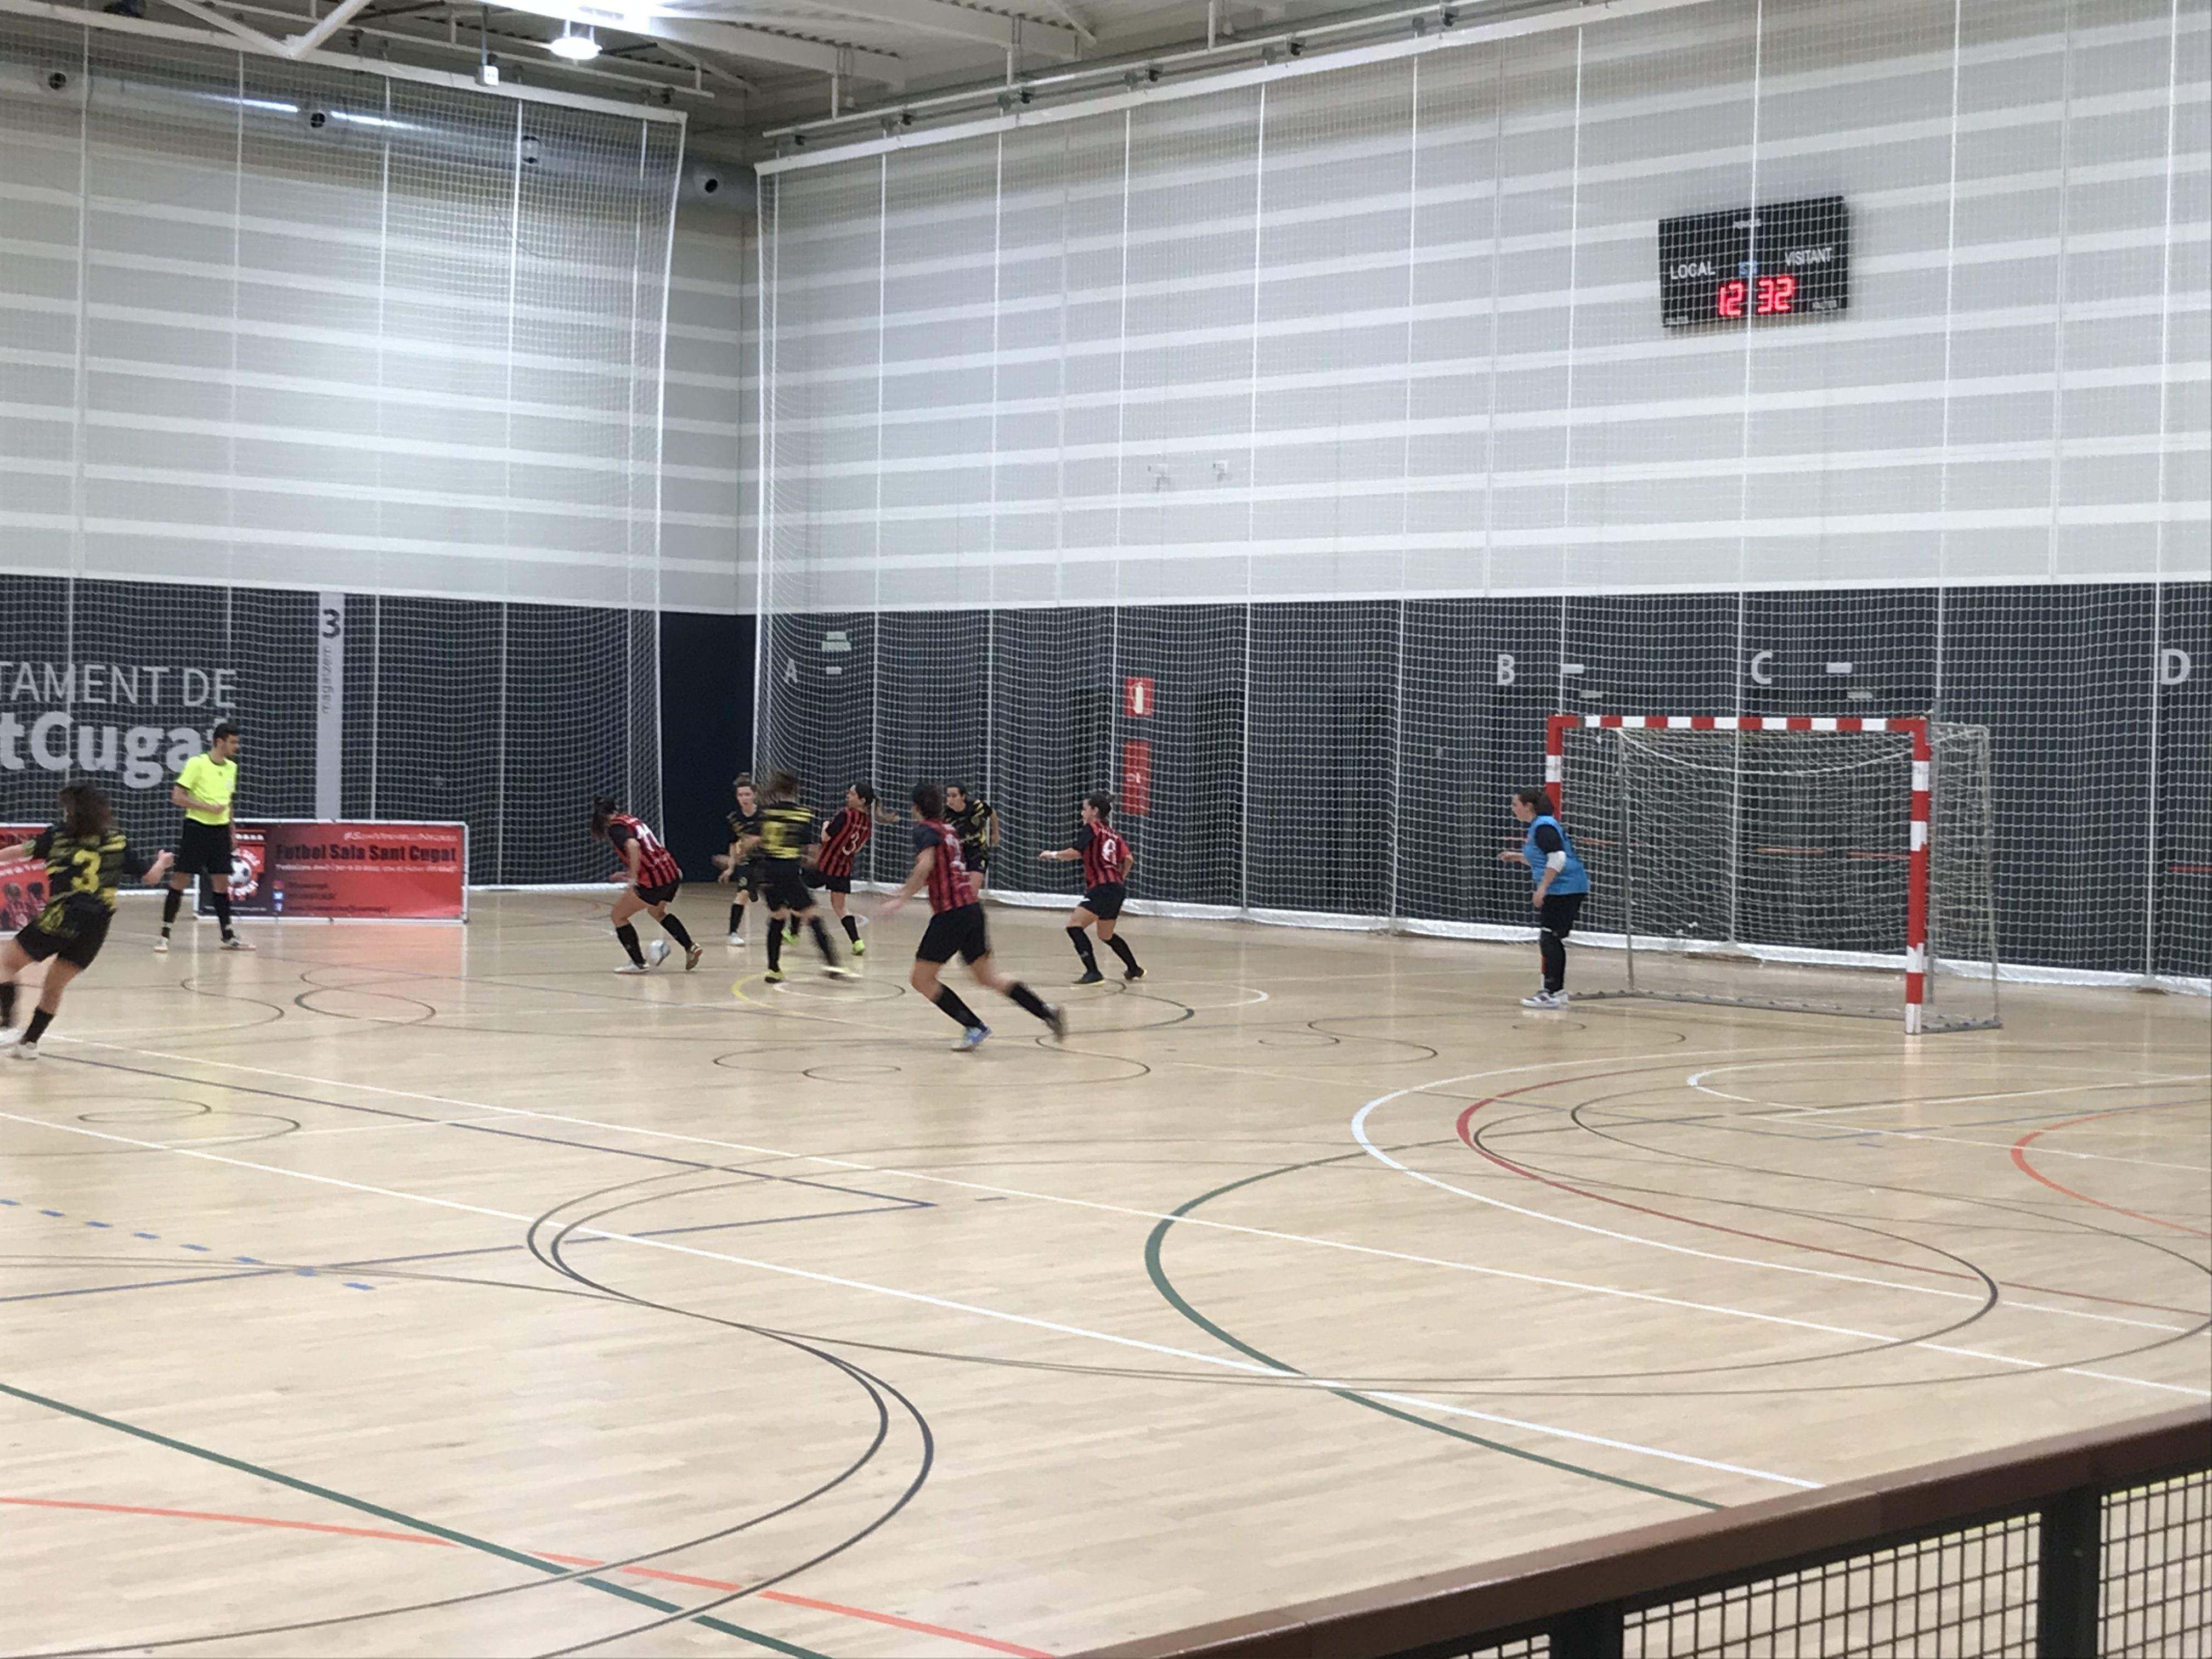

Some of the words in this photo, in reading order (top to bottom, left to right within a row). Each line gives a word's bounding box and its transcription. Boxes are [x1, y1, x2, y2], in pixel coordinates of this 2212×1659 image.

[1671, 261, 1716, 280] LOCAL
[1785, 247, 1832, 267] VISITANT
[1718, 281, 1744, 317] 12
[1757, 275, 1795, 313] 32
[322, 608, 341, 639] 3
[785, 658, 798, 684] A
[1497, 654, 1515, 686] B
[1751, 650, 1774, 685] C
[2160, 648, 2191, 685] D
[183, 667, 236, 708] DE
[275, 844, 326, 860] Futbol
[329, 843, 366, 860] Sala
[369, 844, 405, 861] Sant
[409, 845, 457, 863] Cugat
[71, 849, 101, 893] 3
